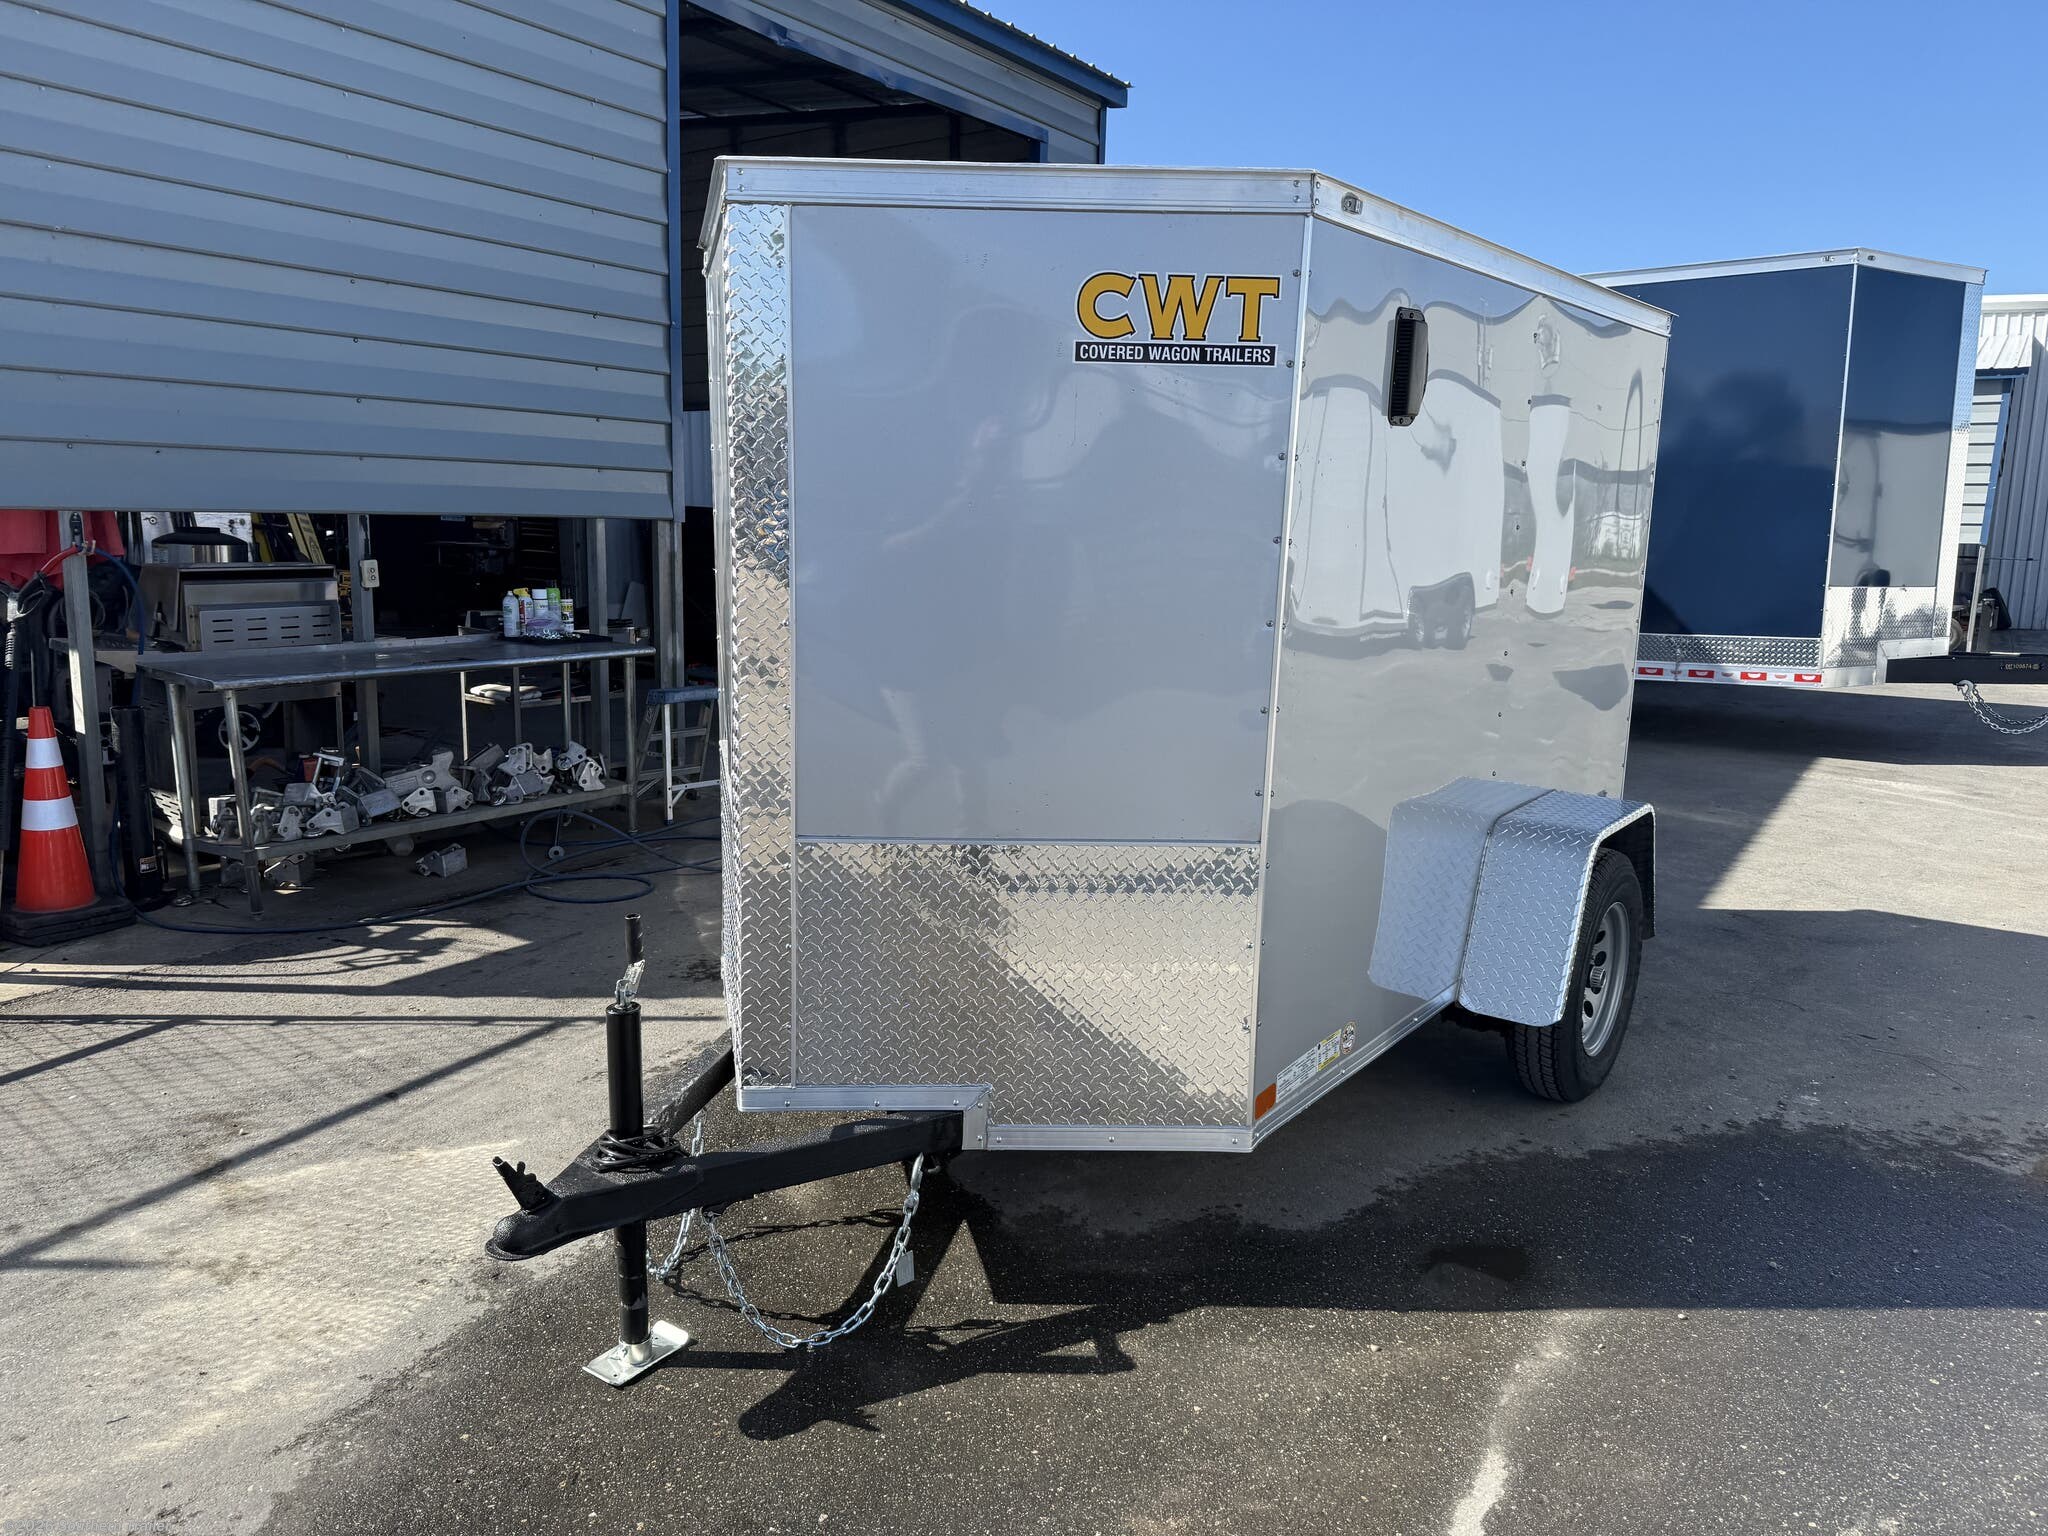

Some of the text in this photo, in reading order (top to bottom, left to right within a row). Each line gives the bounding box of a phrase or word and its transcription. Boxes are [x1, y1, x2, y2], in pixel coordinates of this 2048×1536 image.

[1077, 272, 1280, 342] CWT
[1079, 344, 1271, 363] COVERED WAGON TRAILERS
